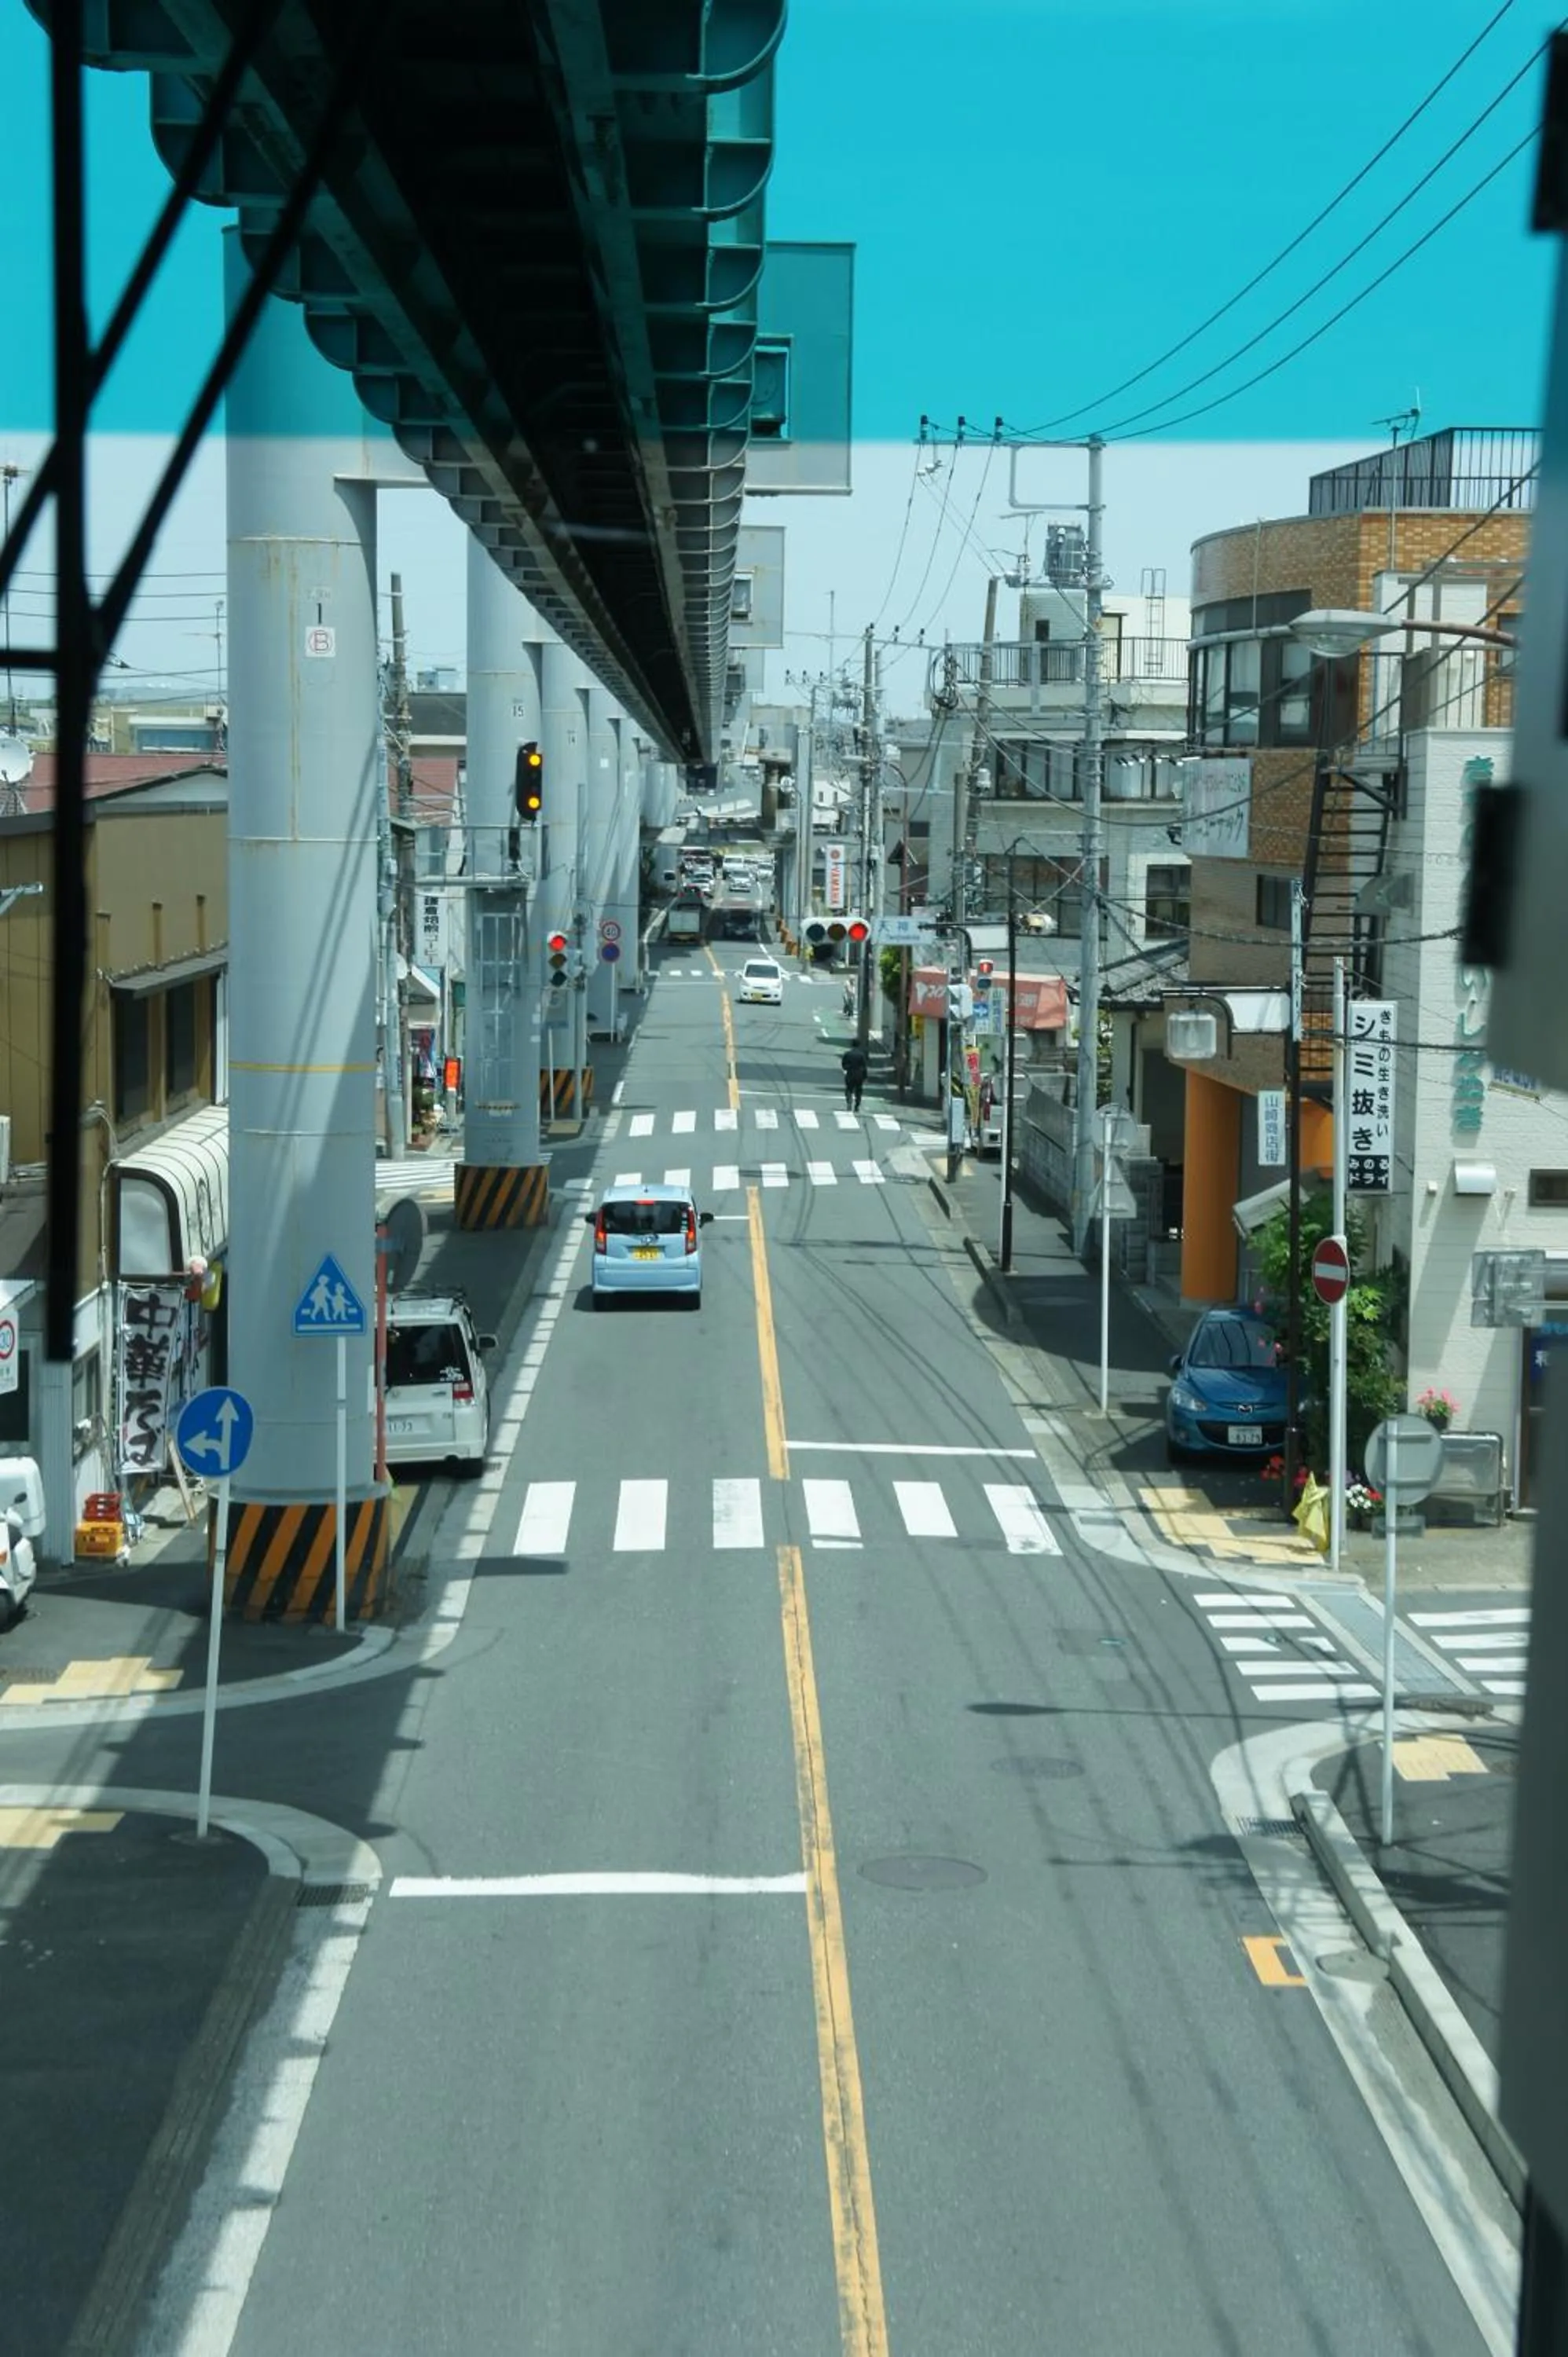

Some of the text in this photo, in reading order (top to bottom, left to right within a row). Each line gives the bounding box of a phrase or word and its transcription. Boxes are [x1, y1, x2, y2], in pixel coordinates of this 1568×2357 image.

[830, 866, 841, 904] YAMAHA
[1349, 1014, 1376, 1151] シミ抜き
[124, 1293, 178, 1467] 中華そば
